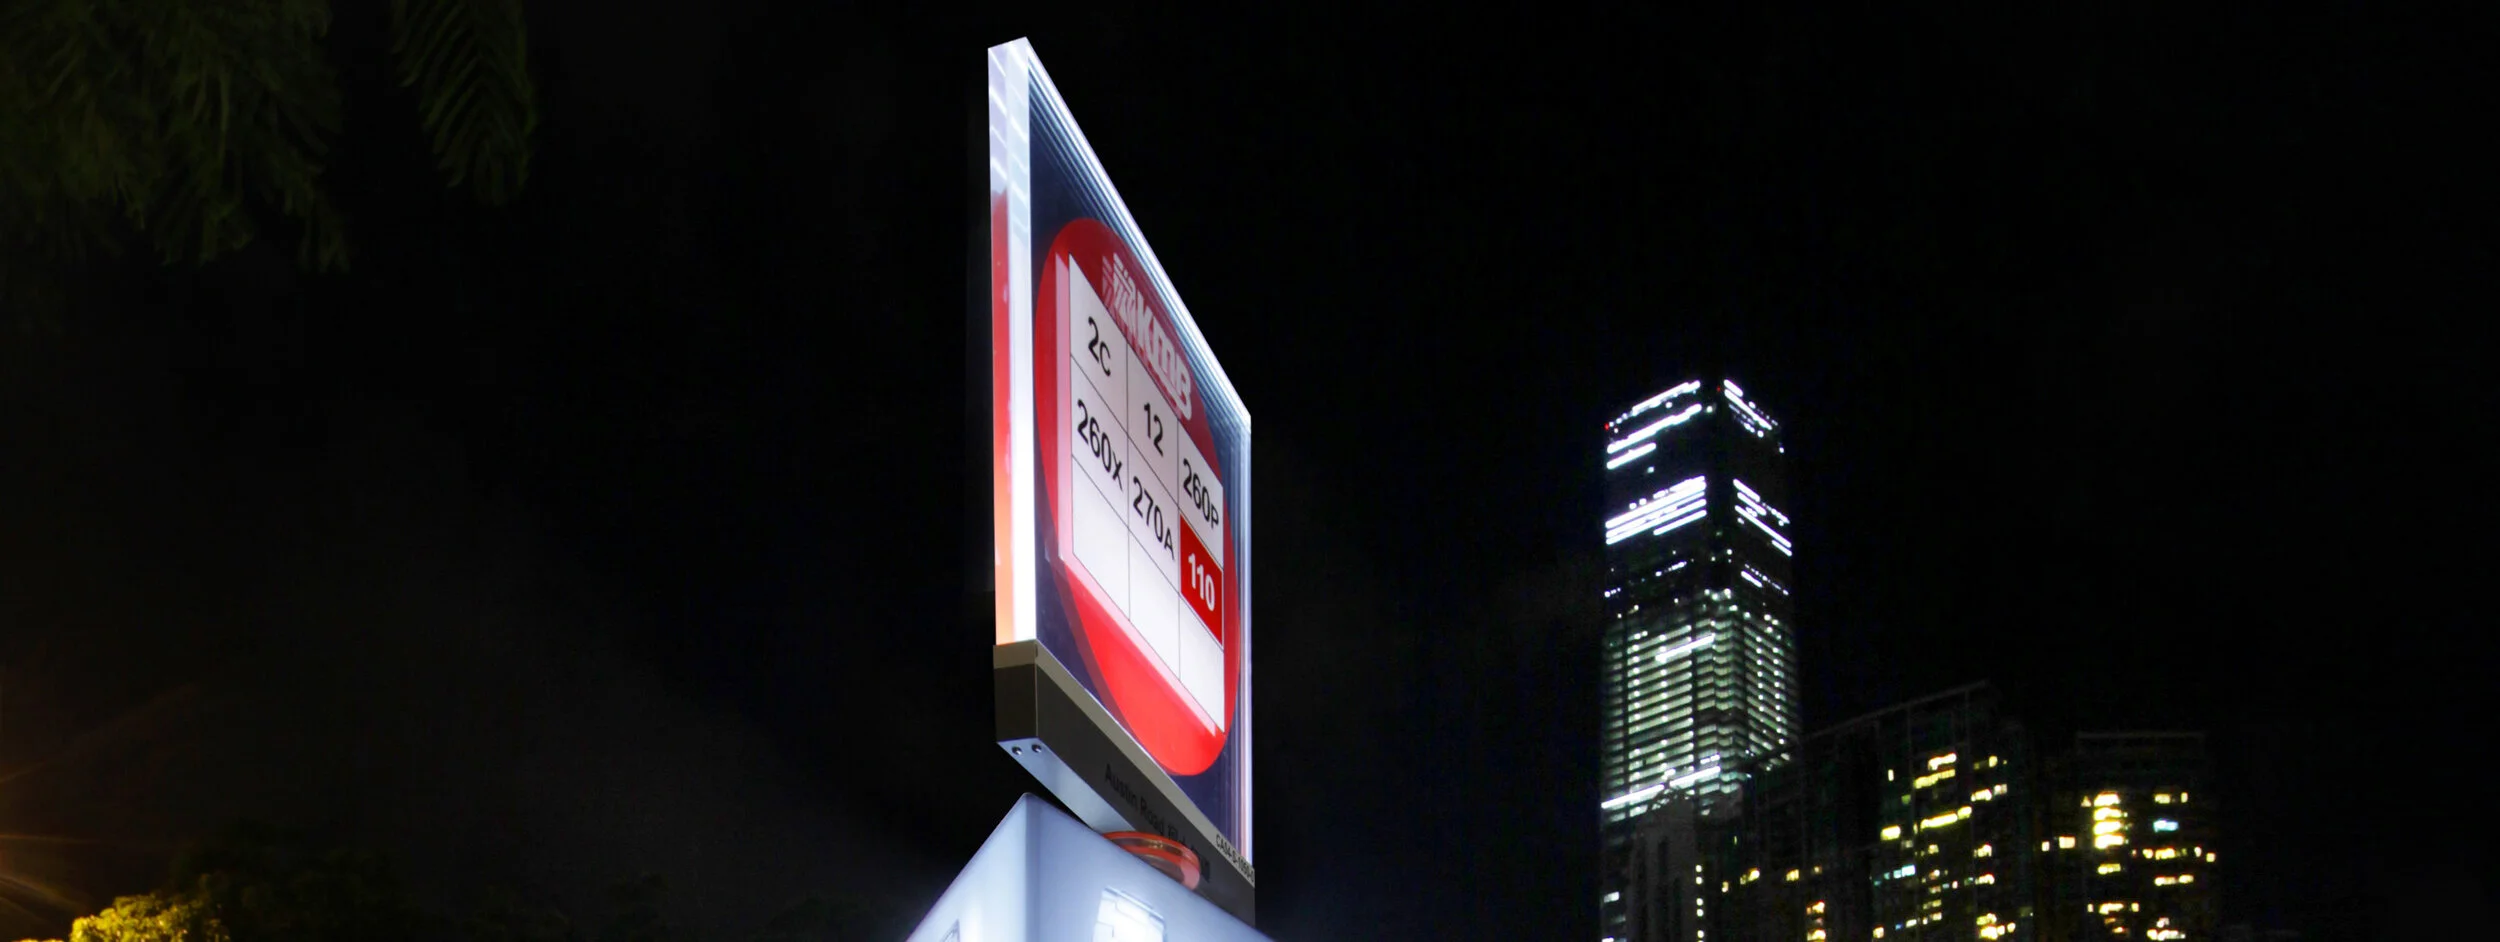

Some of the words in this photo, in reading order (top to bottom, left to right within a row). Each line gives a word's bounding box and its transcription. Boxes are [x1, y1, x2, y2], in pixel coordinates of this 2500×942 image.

[1088, 316, 1111, 377] 2C
[1077, 399, 1123, 492] 260X
[1144, 402, 1163, 457] 12
[1133, 476, 1175, 561] 270A
[1183, 458, 1219, 529] 260P
[1188, 553, 1215, 612] 110
[1105, 763, 1138, 811] Austin
